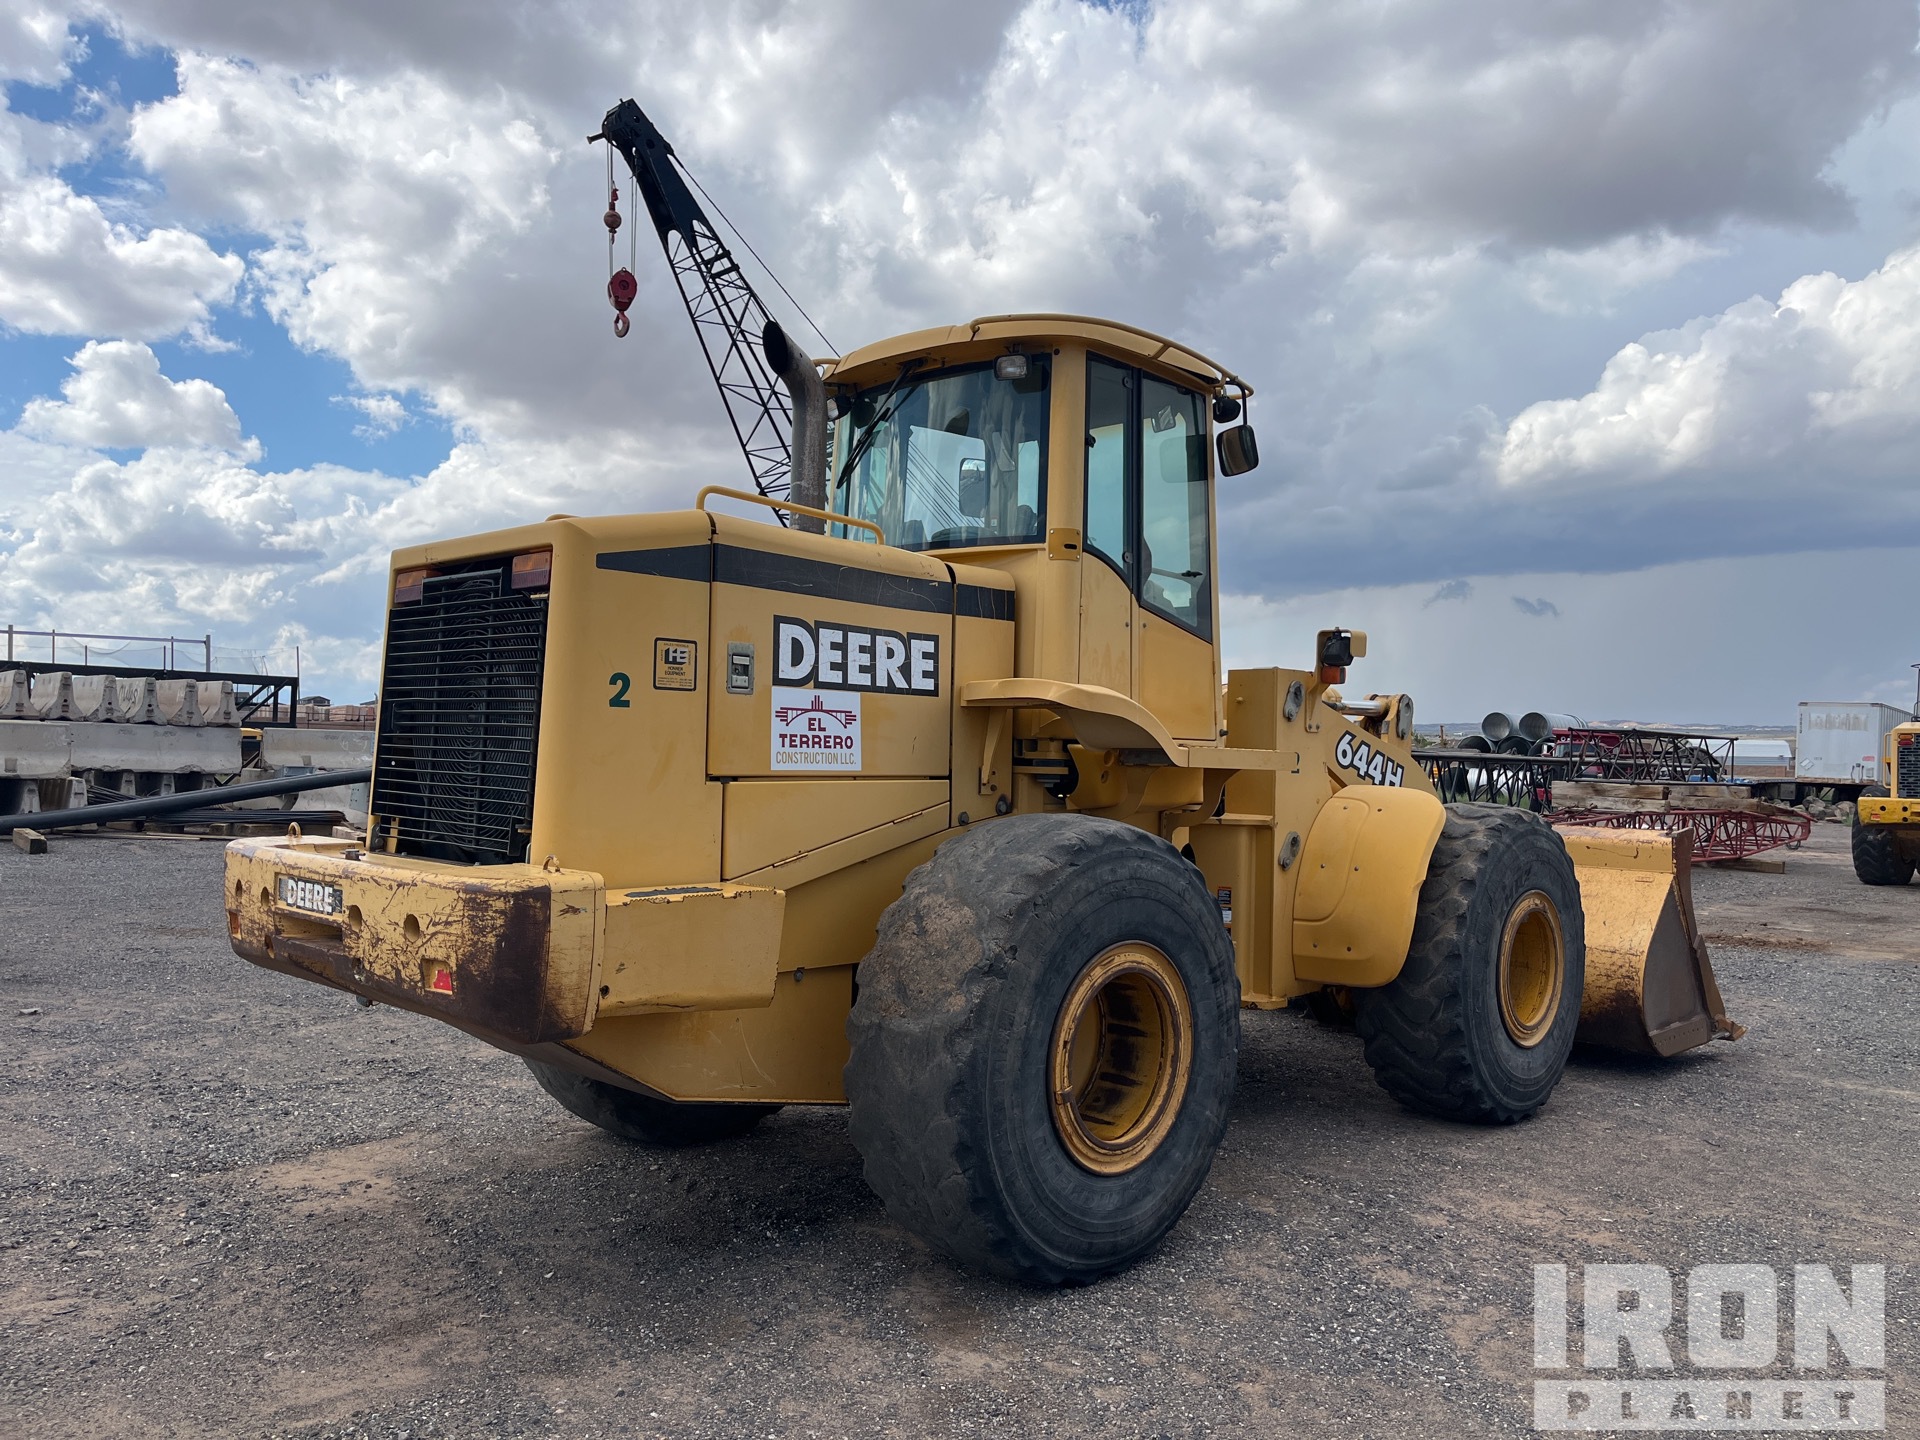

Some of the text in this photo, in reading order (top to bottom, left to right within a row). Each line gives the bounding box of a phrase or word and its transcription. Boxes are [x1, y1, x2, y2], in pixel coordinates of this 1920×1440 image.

[778, 622, 936, 691] DEERE
[608, 672, 631, 708] 2
[778, 733, 854, 750] TERRERO
[807, 717, 827, 732] EL
[775, 751, 839, 765] CONSTRUCTION
[1336, 731, 1405, 788] 644H
[286, 878, 334, 914] DEERE
